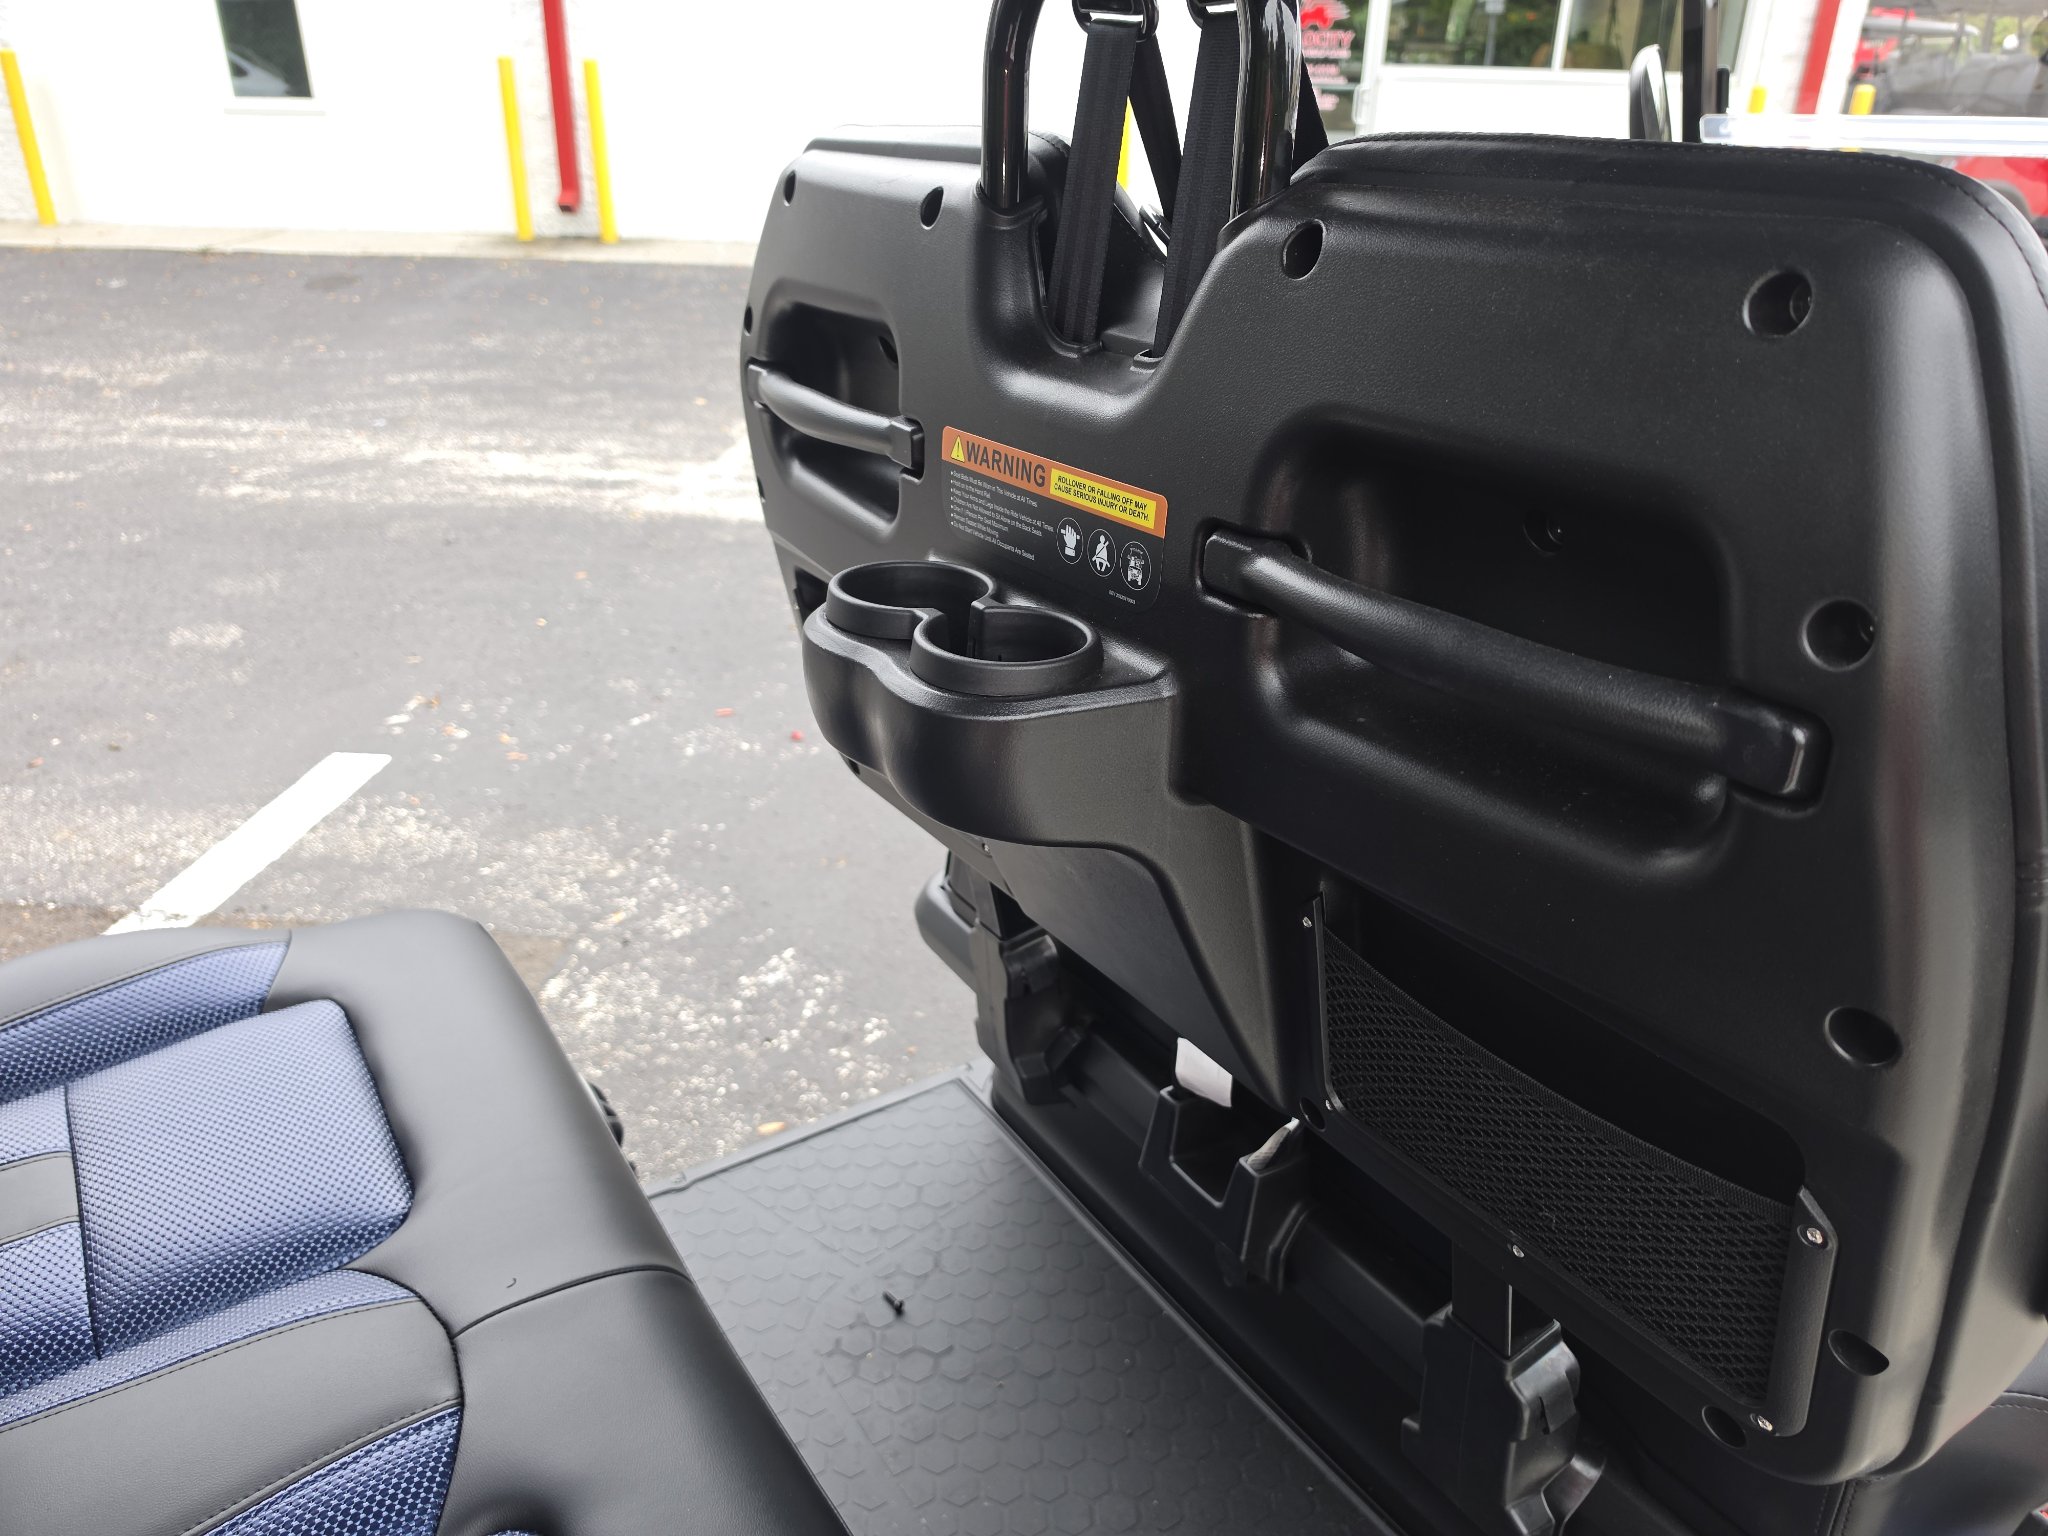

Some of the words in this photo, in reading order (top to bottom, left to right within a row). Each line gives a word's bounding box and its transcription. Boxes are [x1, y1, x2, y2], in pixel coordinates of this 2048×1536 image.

[966, 441, 1045, 487] WARNING
[1054, 483, 1072, 495] CAUSE
[1072, 490, 1096, 504] SERIOUS
[1097, 498, 1118, 511] INJURY
[1118, 505, 1127, 514] OR
[1128, 508, 1149, 521] DEATH.
[1057, 475, 1086, 490] ROLLOVER
[1096, 488, 1120, 503] FALLING
[1121, 496, 1133, 506] OFF
[1134, 501, 1147, 511] MAY
[1018, 512, 1032, 523] Vehicle
